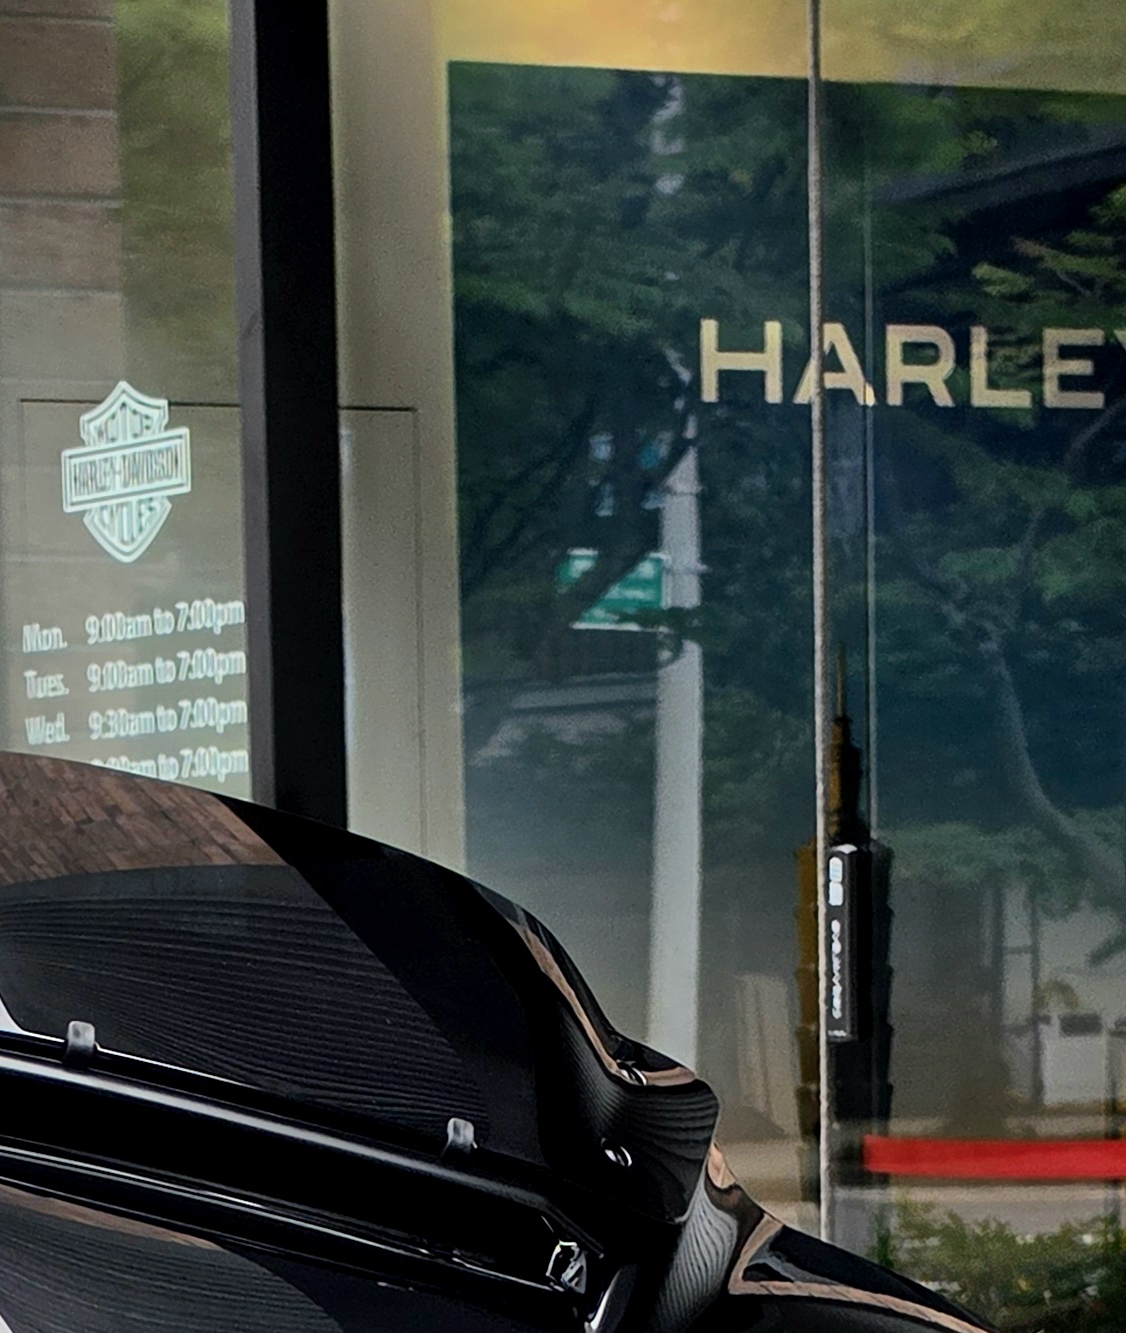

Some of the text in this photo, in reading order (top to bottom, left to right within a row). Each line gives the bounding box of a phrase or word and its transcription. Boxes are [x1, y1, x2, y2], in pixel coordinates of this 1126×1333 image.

[699, 318, 1126, 409] HARLE
[23, 623, 68, 653] Mon.
[153, 607, 174, 635] to
[24, 669, 70, 699] Tues.
[154, 656, 176, 684] to
[25, 712, 70, 745] Wed.
[155, 704, 178, 732] to
[157, 753, 180, 781] to
